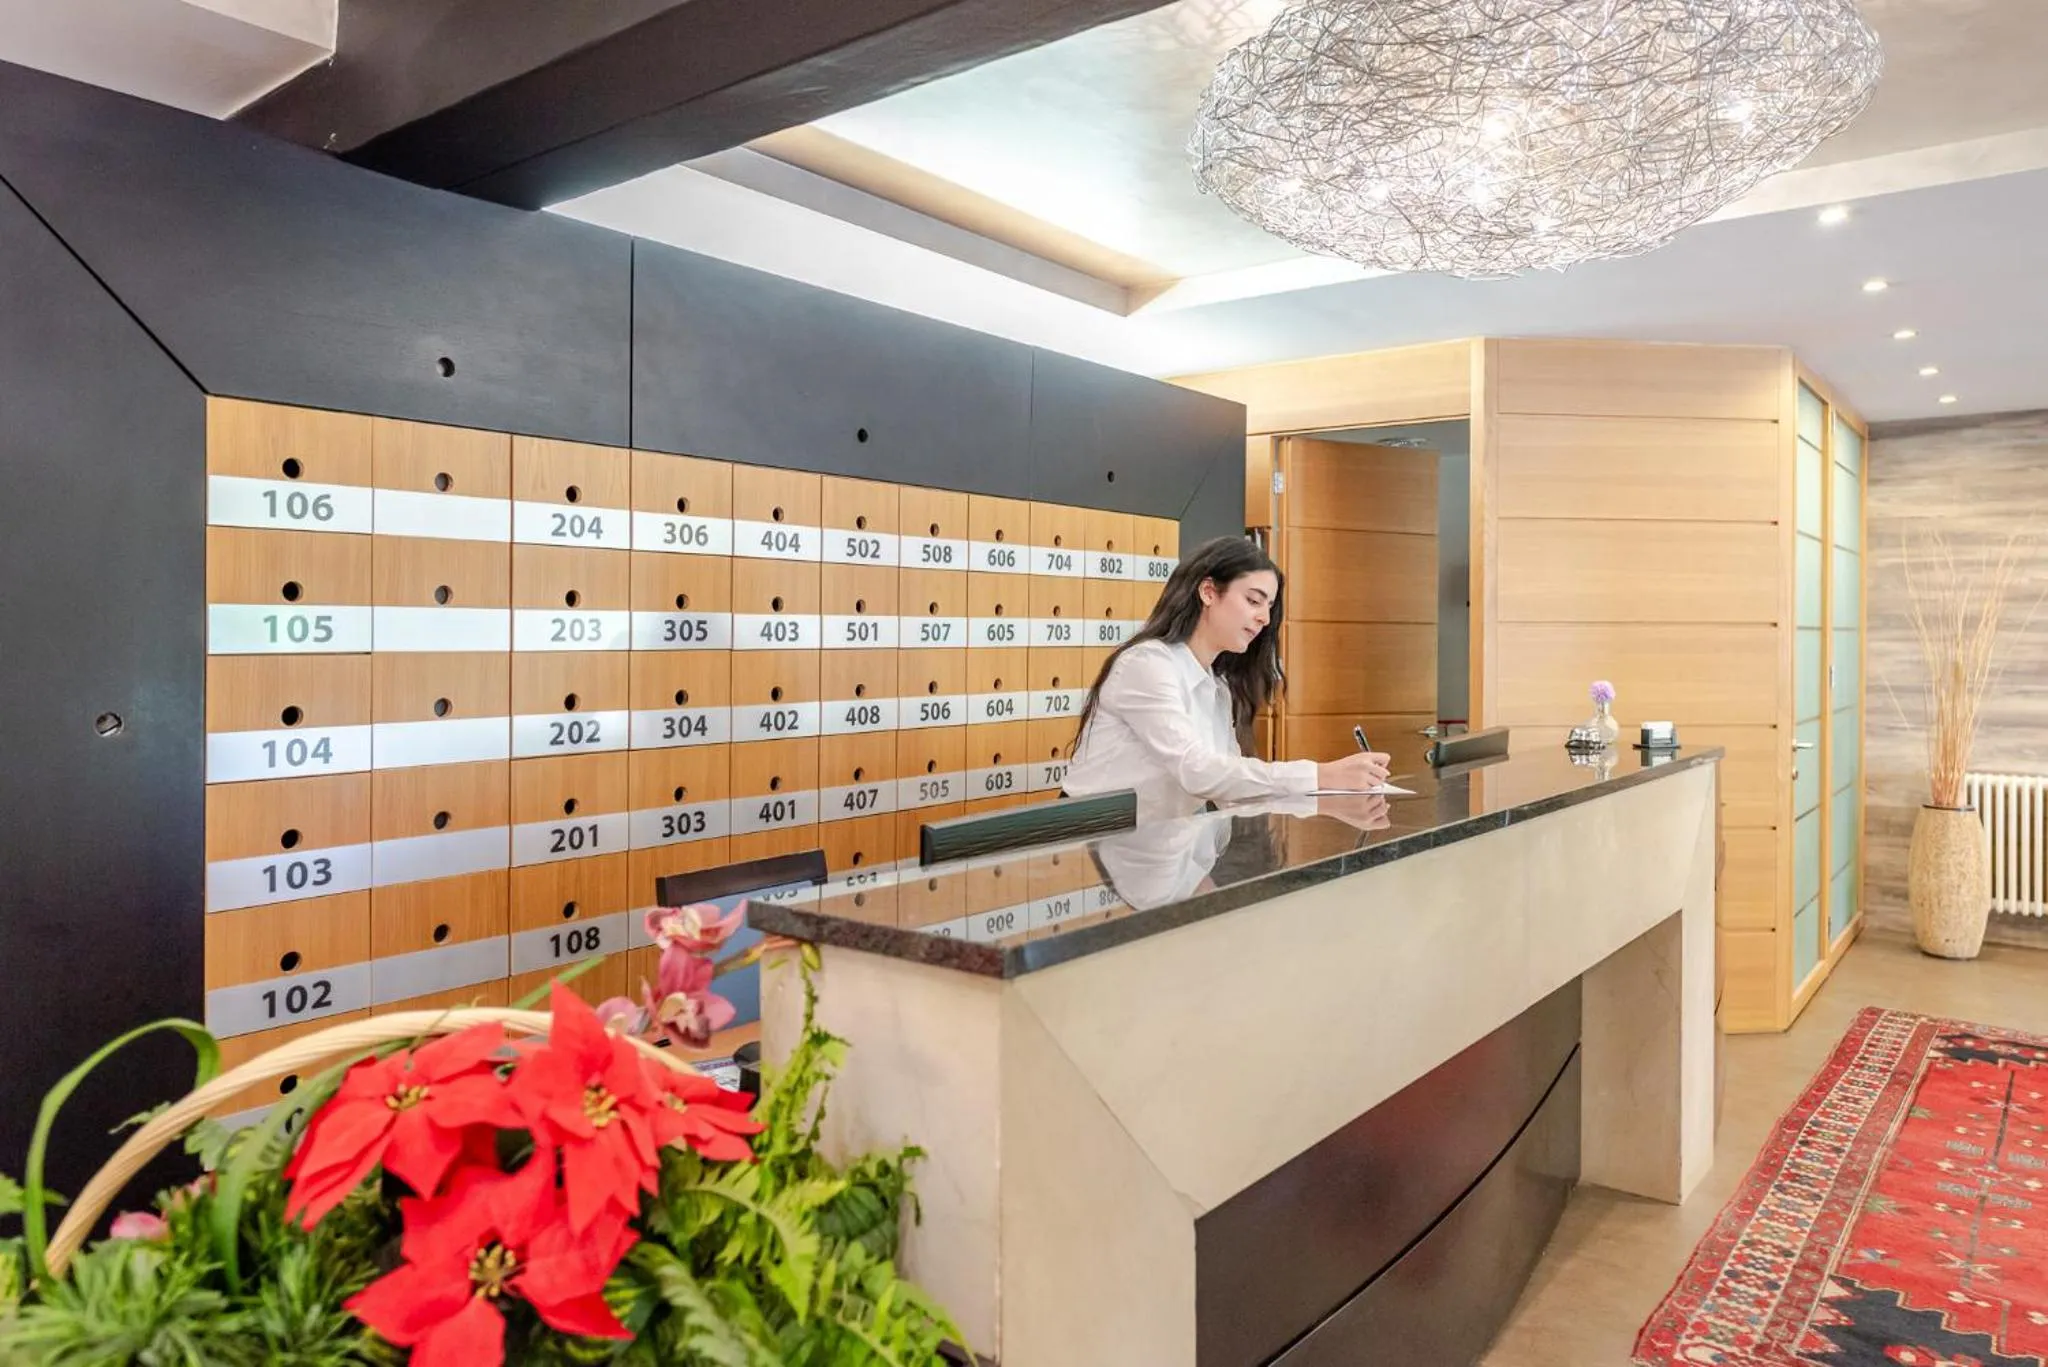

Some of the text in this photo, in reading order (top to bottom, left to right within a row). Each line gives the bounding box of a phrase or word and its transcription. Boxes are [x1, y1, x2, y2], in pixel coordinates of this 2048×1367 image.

[262, 489, 334, 522] 106
[551, 512, 604, 540] 204
[663, 522, 709, 547] 306
[760, 530, 801, 553] 404
[846, 537, 880, 559] 502
[921, 543, 953, 564] 508
[987, 548, 1016, 568] 606
[1047, 553, 1072, 571] 704
[1100, 557, 1123, 574] 802
[1148, 561, 1169, 578] 808
[263, 615, 334, 643] 105
[550, 617, 602, 643] 203
[663, 619, 708, 642] 305
[759, 621, 800, 642] 403
[846, 622, 878, 642] 501
[920, 623, 951, 642] 507
[987, 623, 1015, 642] 605
[1046, 624, 1071, 641] 703
[1098, 624, 1121, 641] 801
[919, 701, 951, 722] 506
[986, 698, 1014, 718] 604
[1045, 694, 1070, 713] 702
[662, 714, 708, 739] 304
[759, 709, 799, 733] 402
[845, 705, 881, 727] 408
[549, 720, 601, 746] 202
[262, 736, 333, 769] 104
[919, 779, 950, 801] 505
[985, 771, 1013, 792] 603
[843, 788, 879, 811] 407
[758, 799, 796, 823] 401
[662, 810, 706, 838] 303
[550, 824, 599, 853] 201
[262, 858, 332, 893] 103
[550, 926, 601, 958] 108
[262, 980, 332, 1019] 102
